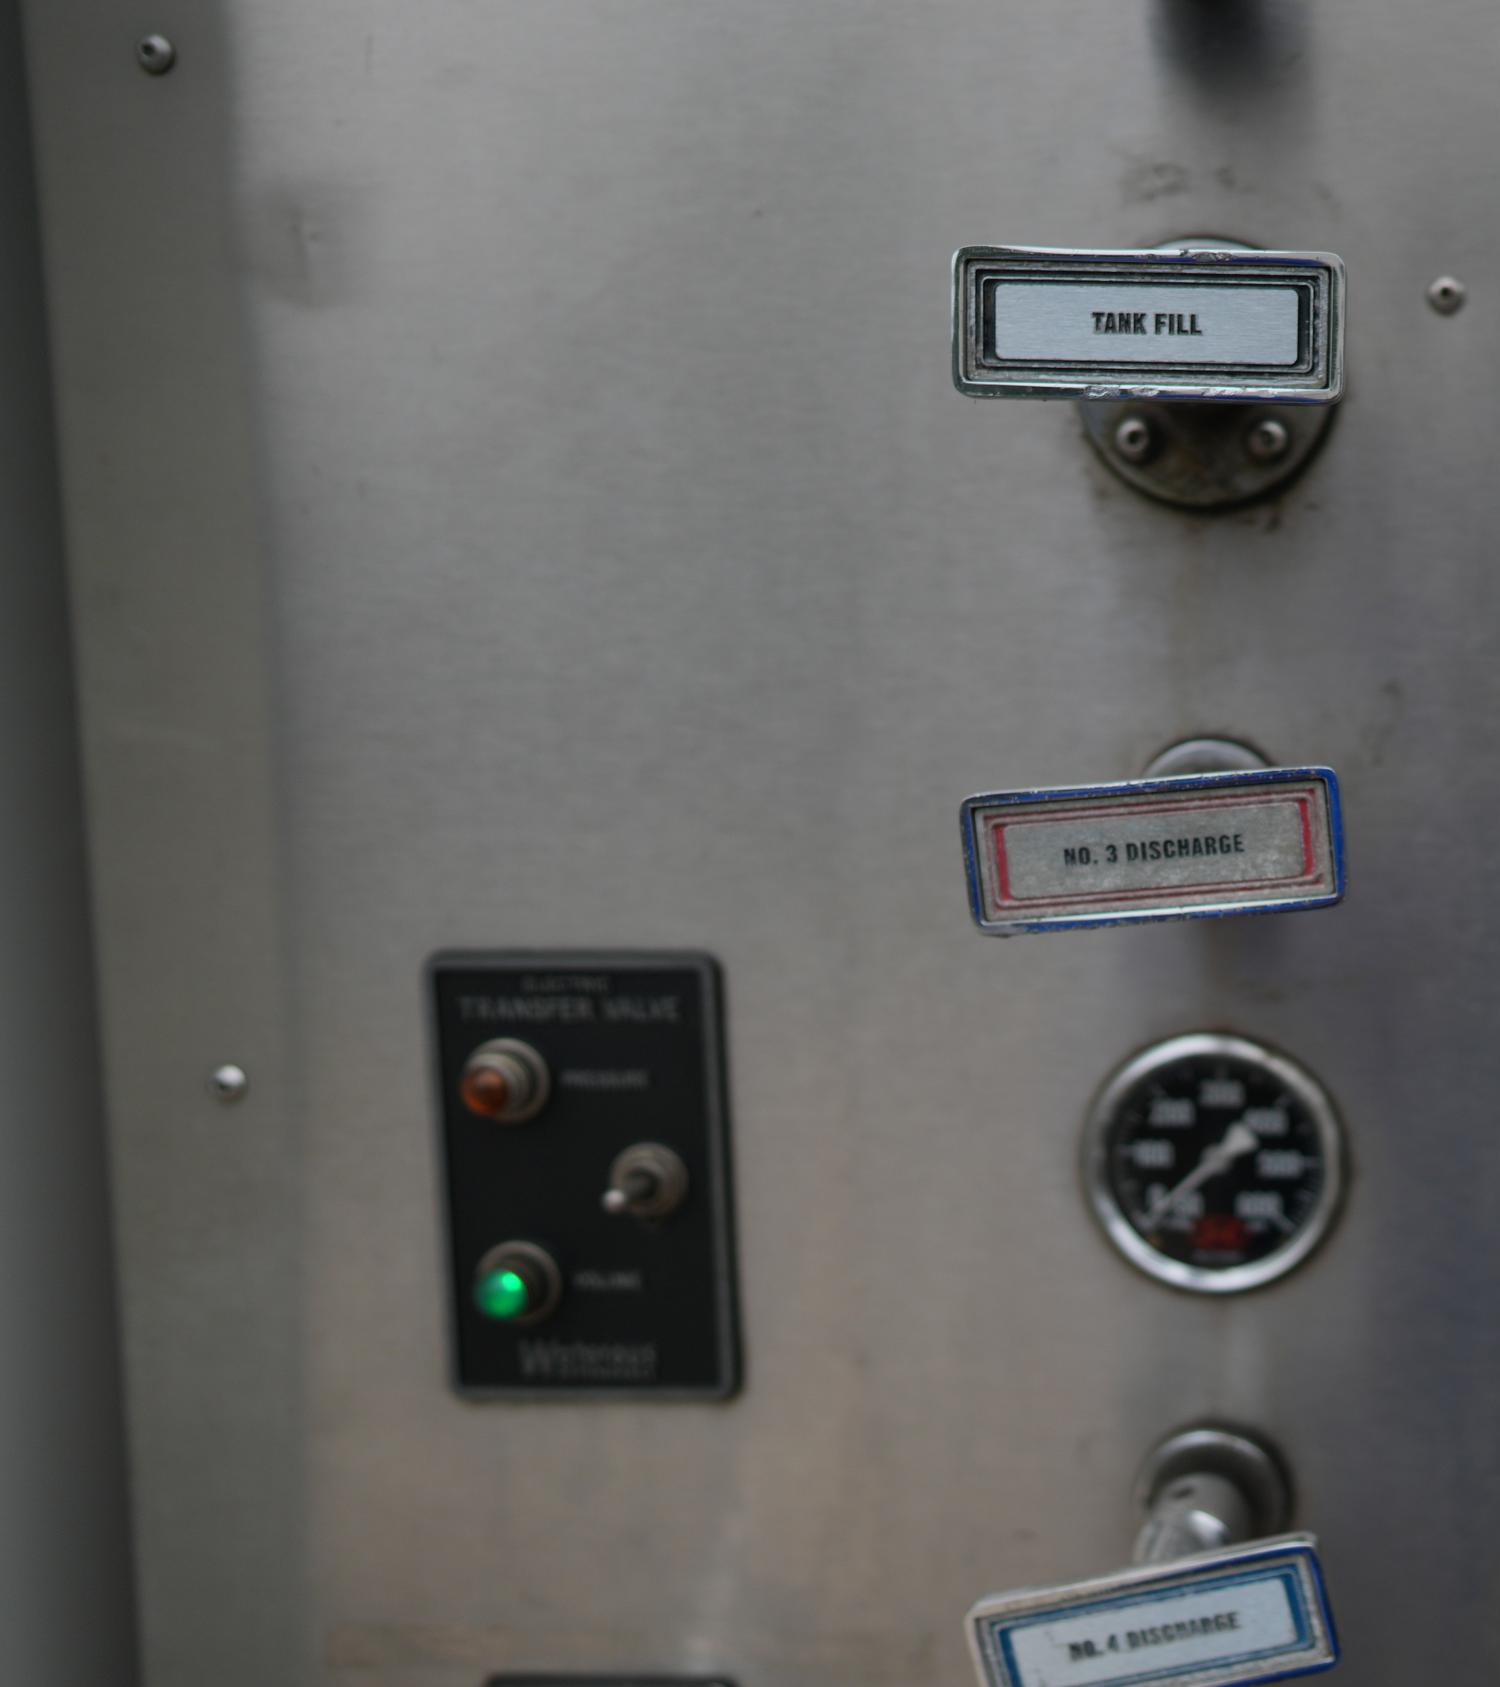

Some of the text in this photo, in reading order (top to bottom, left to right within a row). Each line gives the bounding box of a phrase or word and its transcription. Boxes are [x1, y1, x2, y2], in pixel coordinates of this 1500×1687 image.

[1092, 312, 1203, 336] TANK FILL
[1064, 834, 1245, 867] NO. 3 DISCHARGE
[1067, 1611, 1242, 1663] NO. 4 DISCHARGE
